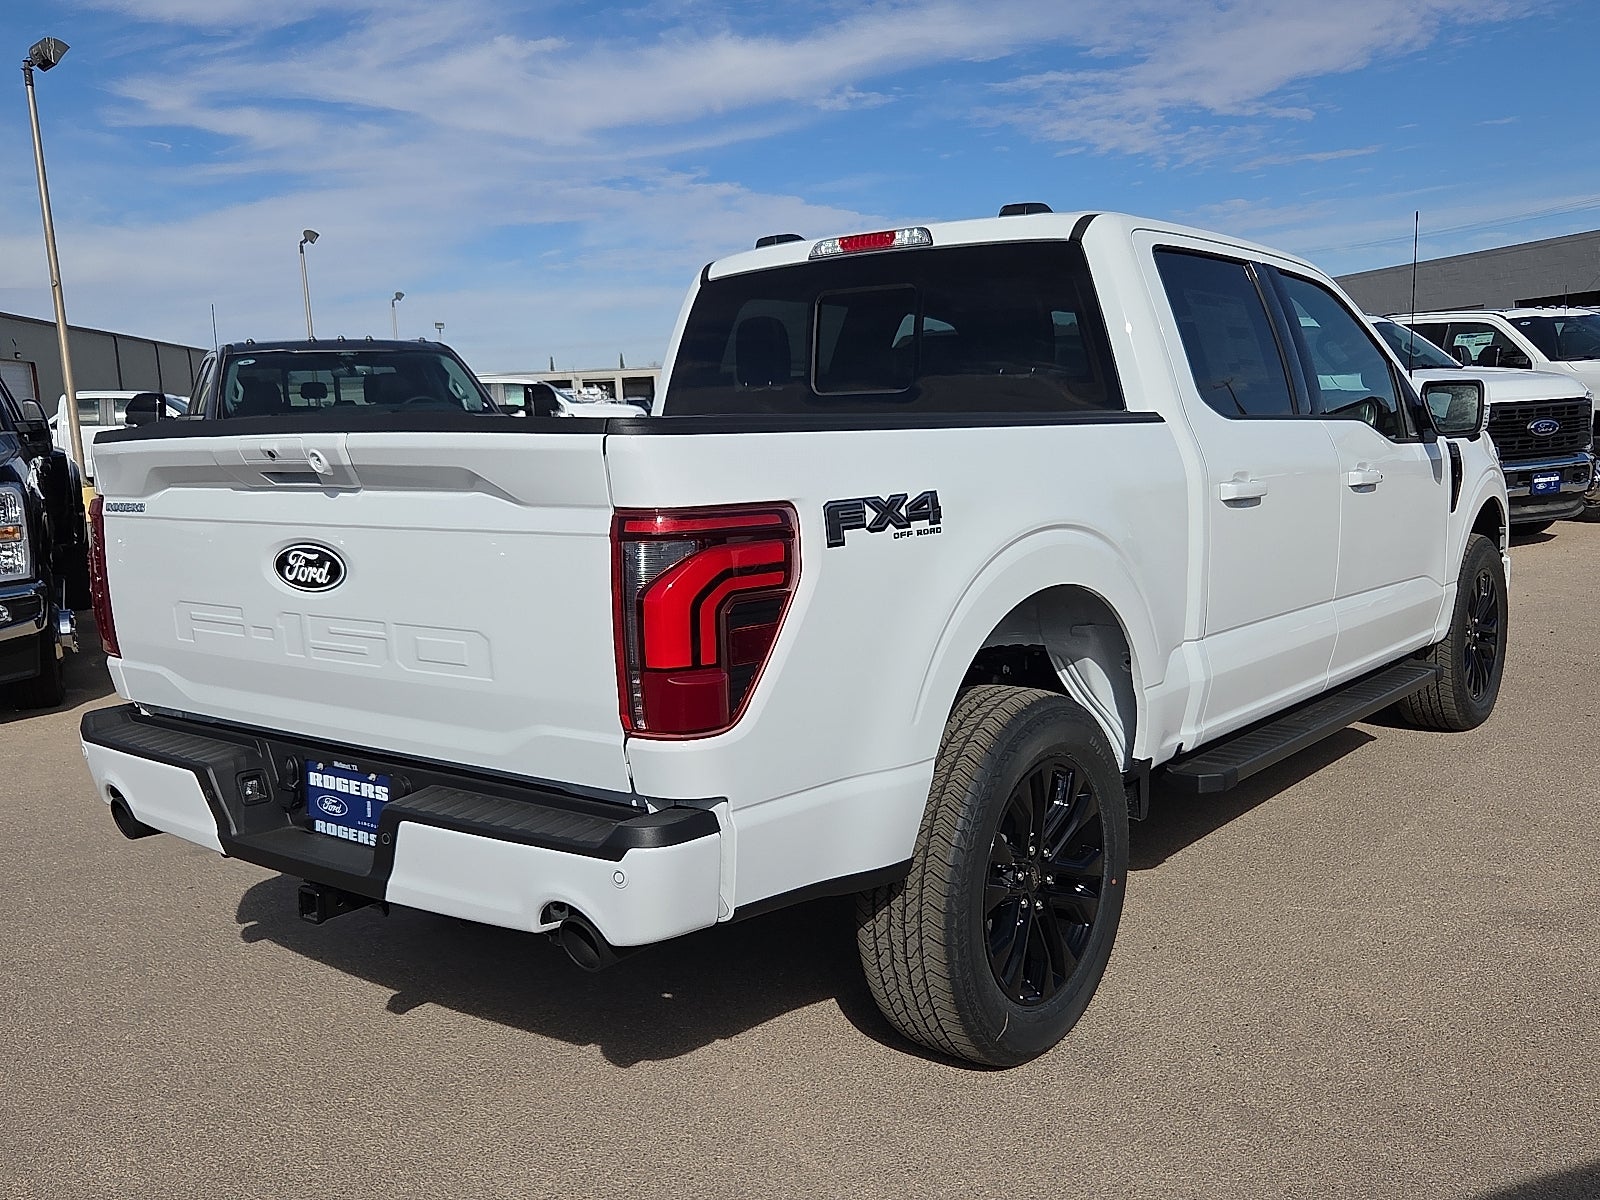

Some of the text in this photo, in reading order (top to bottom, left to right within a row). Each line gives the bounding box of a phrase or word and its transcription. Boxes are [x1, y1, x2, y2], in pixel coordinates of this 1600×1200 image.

[822, 490, 942, 549] FX4
[893, 526, 942, 540] OFF ROAD
[285, 550, 331, 584] Ford
[173, 600, 494, 681] F-150
[308, 771, 389, 802] ROGERS
[321, 797, 342, 814] Ford
[315, 819, 378, 847] ROGERS
